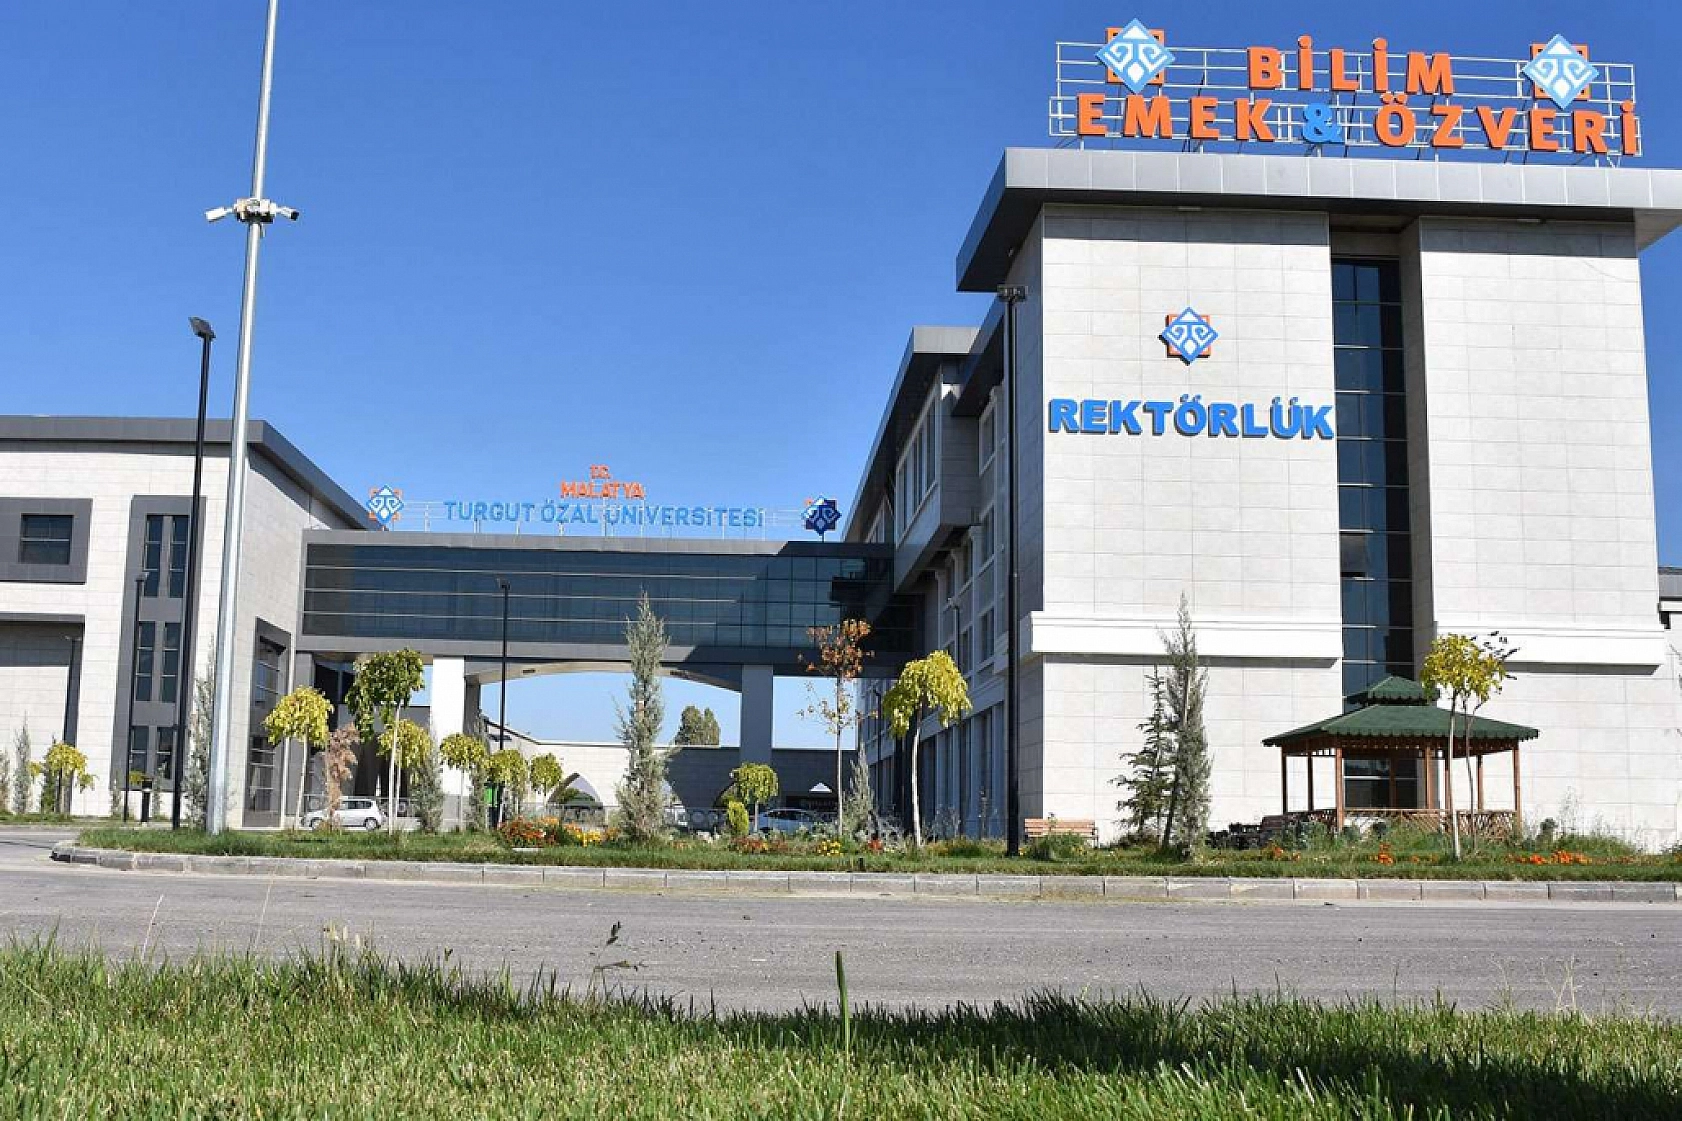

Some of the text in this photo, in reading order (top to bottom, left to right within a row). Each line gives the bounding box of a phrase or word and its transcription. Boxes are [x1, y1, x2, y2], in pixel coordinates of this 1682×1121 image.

[1247, 35, 1454, 96] BİLİM
[1076, 93, 1639, 156] EMEK & ÖZVERİ
[1048, 393, 1335, 439] REKTÖRLÜK
[444, 501, 535, 521] TURGUT
[540, 499, 599, 523] ÖZAL
[560, 481, 645, 498] MALATYA
